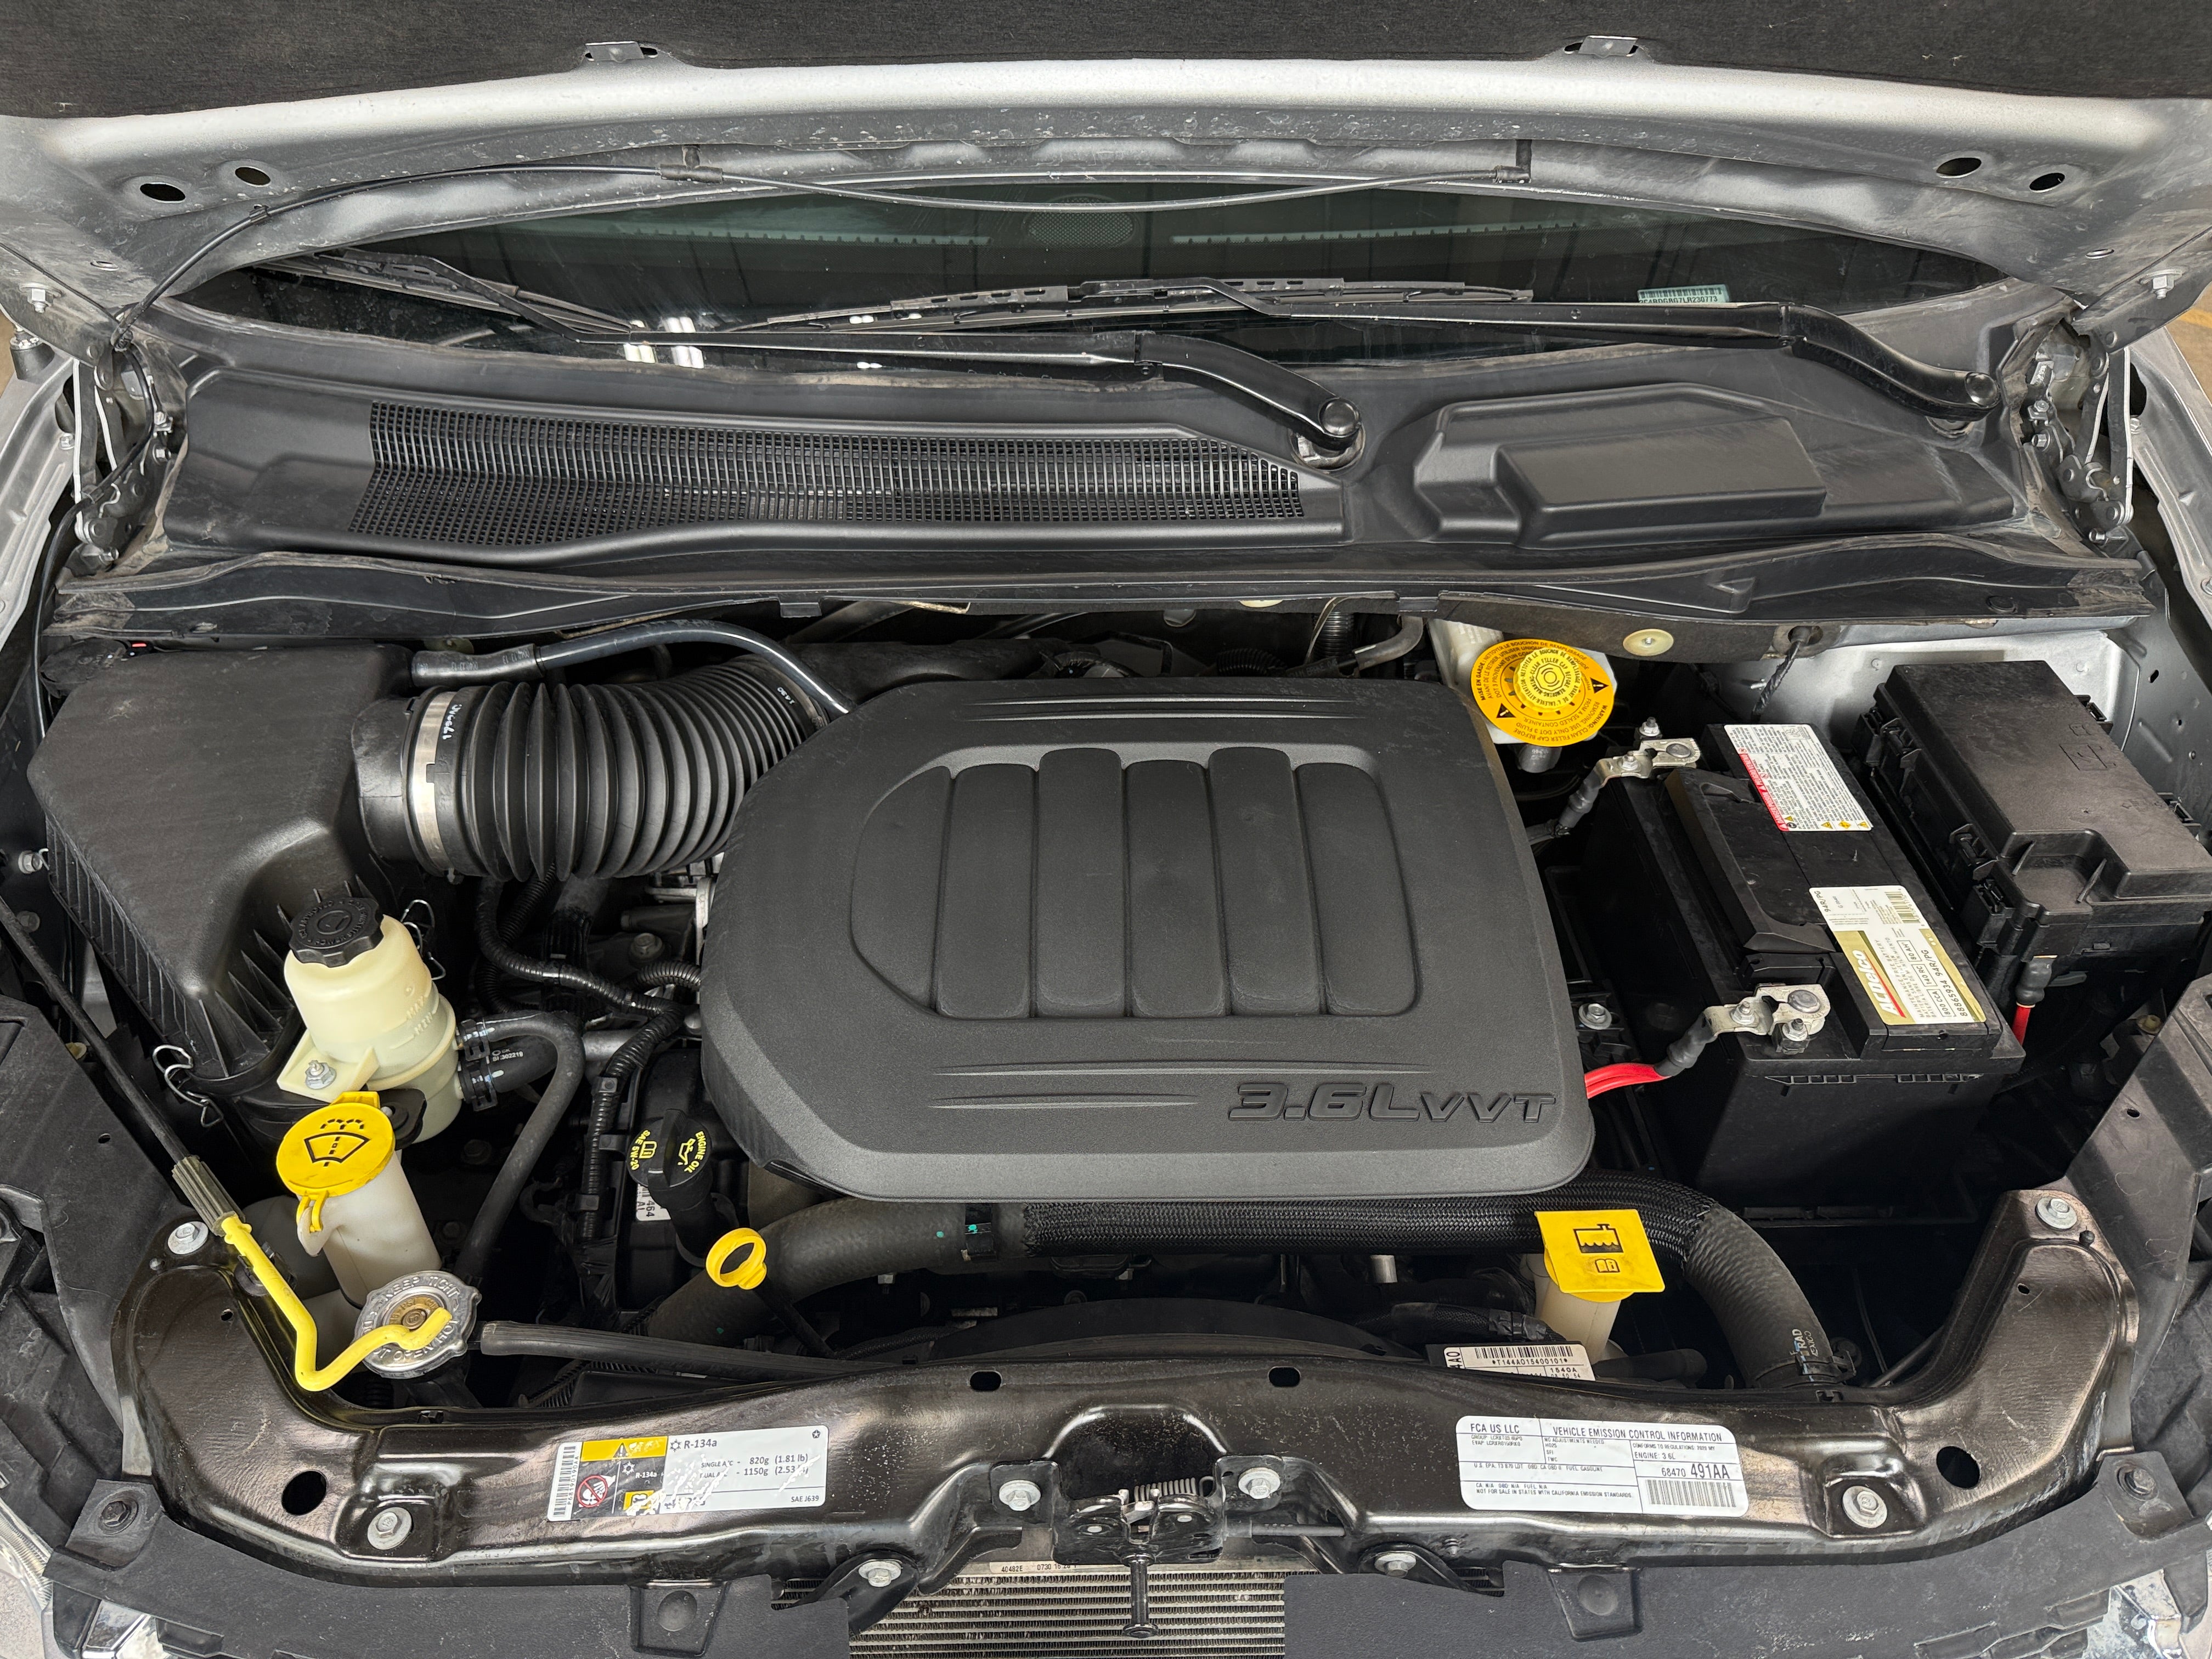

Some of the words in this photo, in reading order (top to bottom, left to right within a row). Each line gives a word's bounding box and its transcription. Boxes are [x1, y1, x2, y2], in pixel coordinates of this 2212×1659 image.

[1582, 698, 1592, 712] FROM
[1516, 722, 1533, 732] FLUID
[1560, 715, 1579, 725] SEALED
[1514, 728, 1536, 740] BEFORE
[1571, 727, 1588, 737] CLEAN
[1874, 939, 1892, 961] BATTERY
[1888, 963, 1901, 977] FREE
[1920, 949, 1943, 976] 94R/PG
[1850, 949, 1899, 1015] ACDelco
[1921, 974, 1932, 984] 140
[1897, 979, 1925, 1017] MAINTENANCE
[1931, 991, 1943, 1002] CCA
[1939, 980, 1968, 1016] 88865934
[1938, 1003, 1951, 1014] 800
[414, 1012, 433, 1035] MIN
[1228, 1083, 1420, 1121] 3.6L
[1421, 1093, 1555, 1123] VVT
[635, 1130, 651, 1145] SAE
[695, 1131, 707, 1160] ENGINE
[630, 1146, 640, 1170] 5W-20
[684, 1161, 699, 1173] OIL
[385, 1277, 420, 1301] KEEP
[429, 1276, 461, 1297] TIGHT
[1792, 1329, 1807, 1348] RAD
[1471, 1424, 1487, 1432] FCA
[1490, 1424, 1501, 1433] US
[1504, 1425, 1520, 1434] LLC
[1553, 1426, 1586, 1437] VEHICLE
[1589, 1427, 1626, 1438] EMISSION
[1629, 1430, 1665, 1440] CONTROL
[1668, 1431, 1722, 1442] INFORMATION
[684, 1438, 717, 1449] R-134a
[749, 1457, 769, 1465] 820g
[775, 1455, 795, 1465] (1.81
[797, 1454, 808, 1463] lb)
[744, 1468, 768, 1476] 1150g
[775, 1466, 795, 1475] (2.53
[1662, 1468, 1686, 1477] 68470
[1690, 1463, 1730, 1480] 491AA
